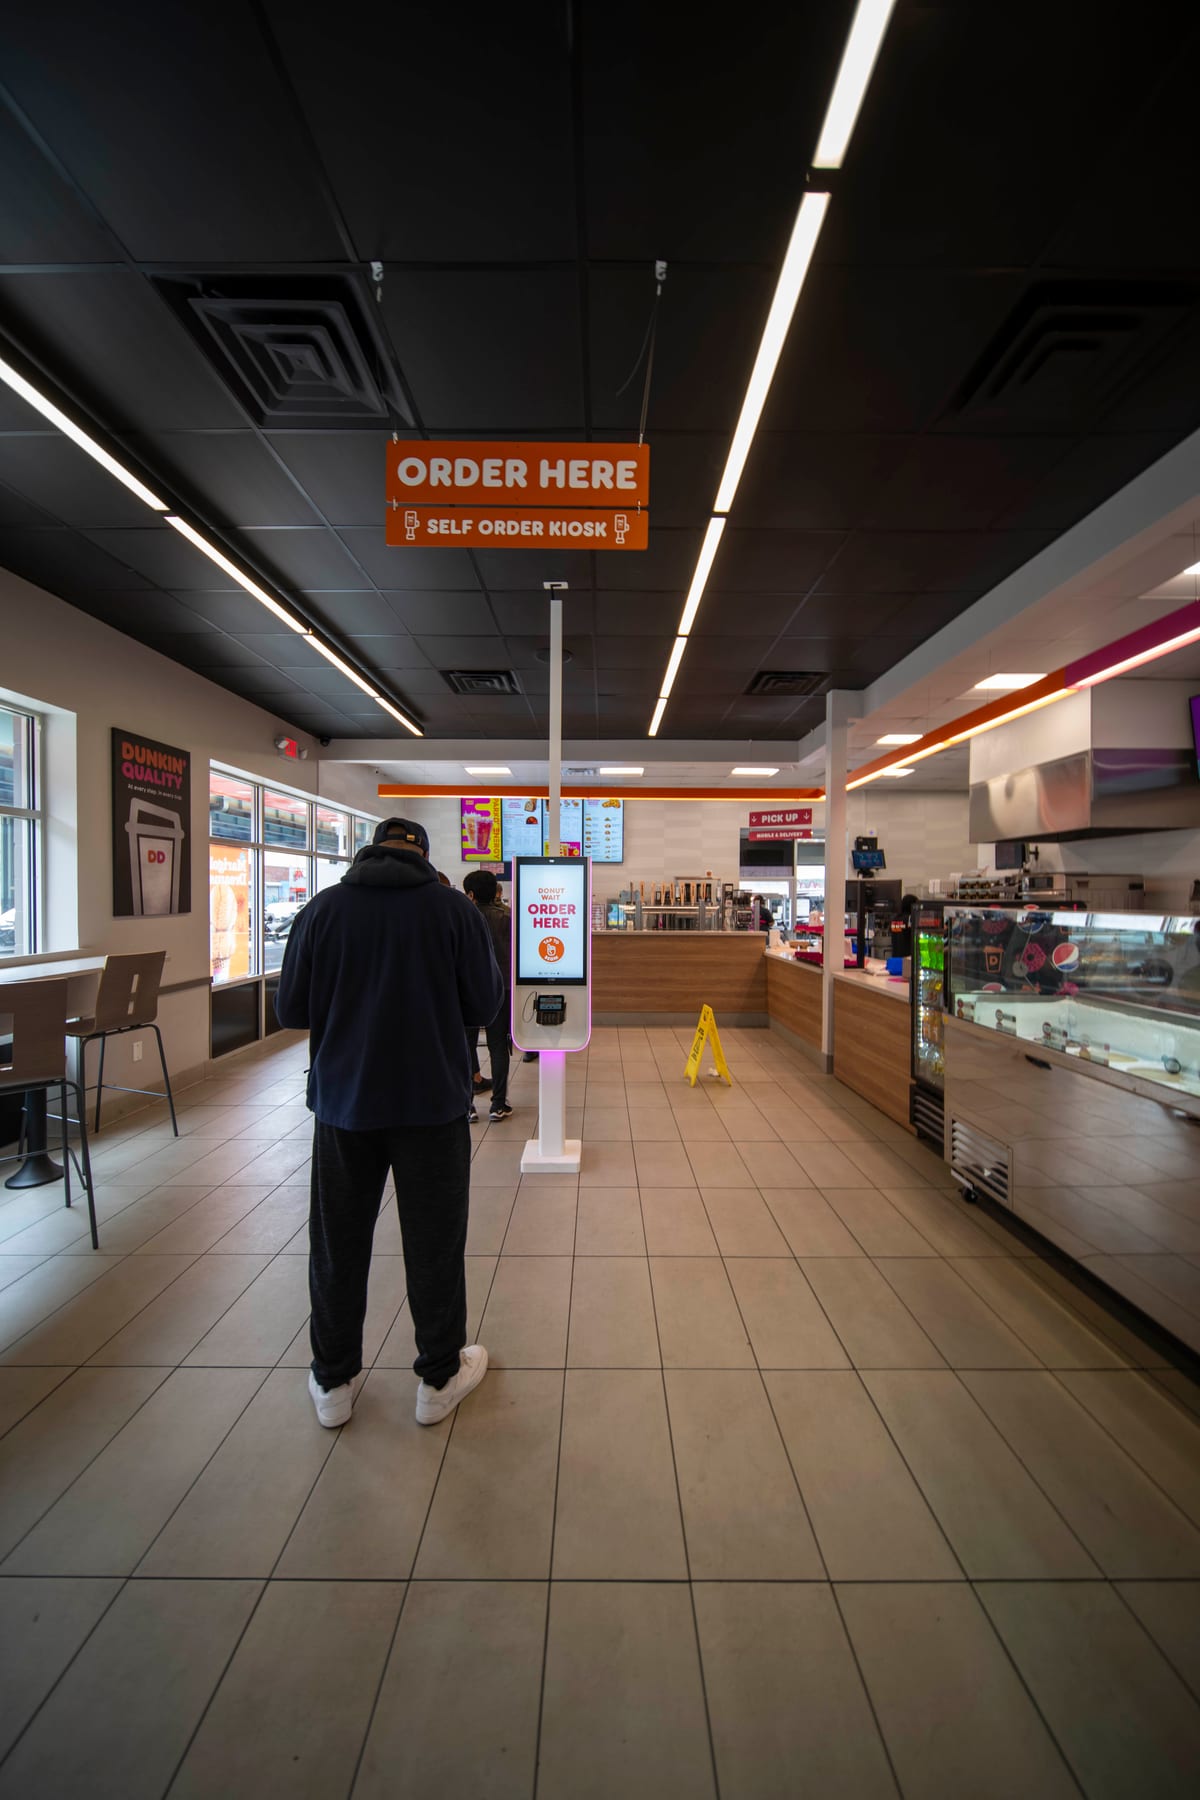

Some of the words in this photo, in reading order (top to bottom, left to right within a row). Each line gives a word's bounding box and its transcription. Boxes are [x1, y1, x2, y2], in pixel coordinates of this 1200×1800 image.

[397, 457, 528, 488] ORDER
[539, 459, 638, 490] HERE
[427, 518, 474, 535] SELF
[478, 520, 544, 536] ORDER
[549, 520, 608, 537] KIOSK
[121, 741, 187, 776] DUNKIN'
[121, 761, 183, 790] QUALITY
[761, 814, 784, 824] PICK
[785, 813, 798, 822] UP
[148, 849, 166, 864] DD
[527, 903, 576, 915] ORDER
[533, 917, 569, 929] HERE
